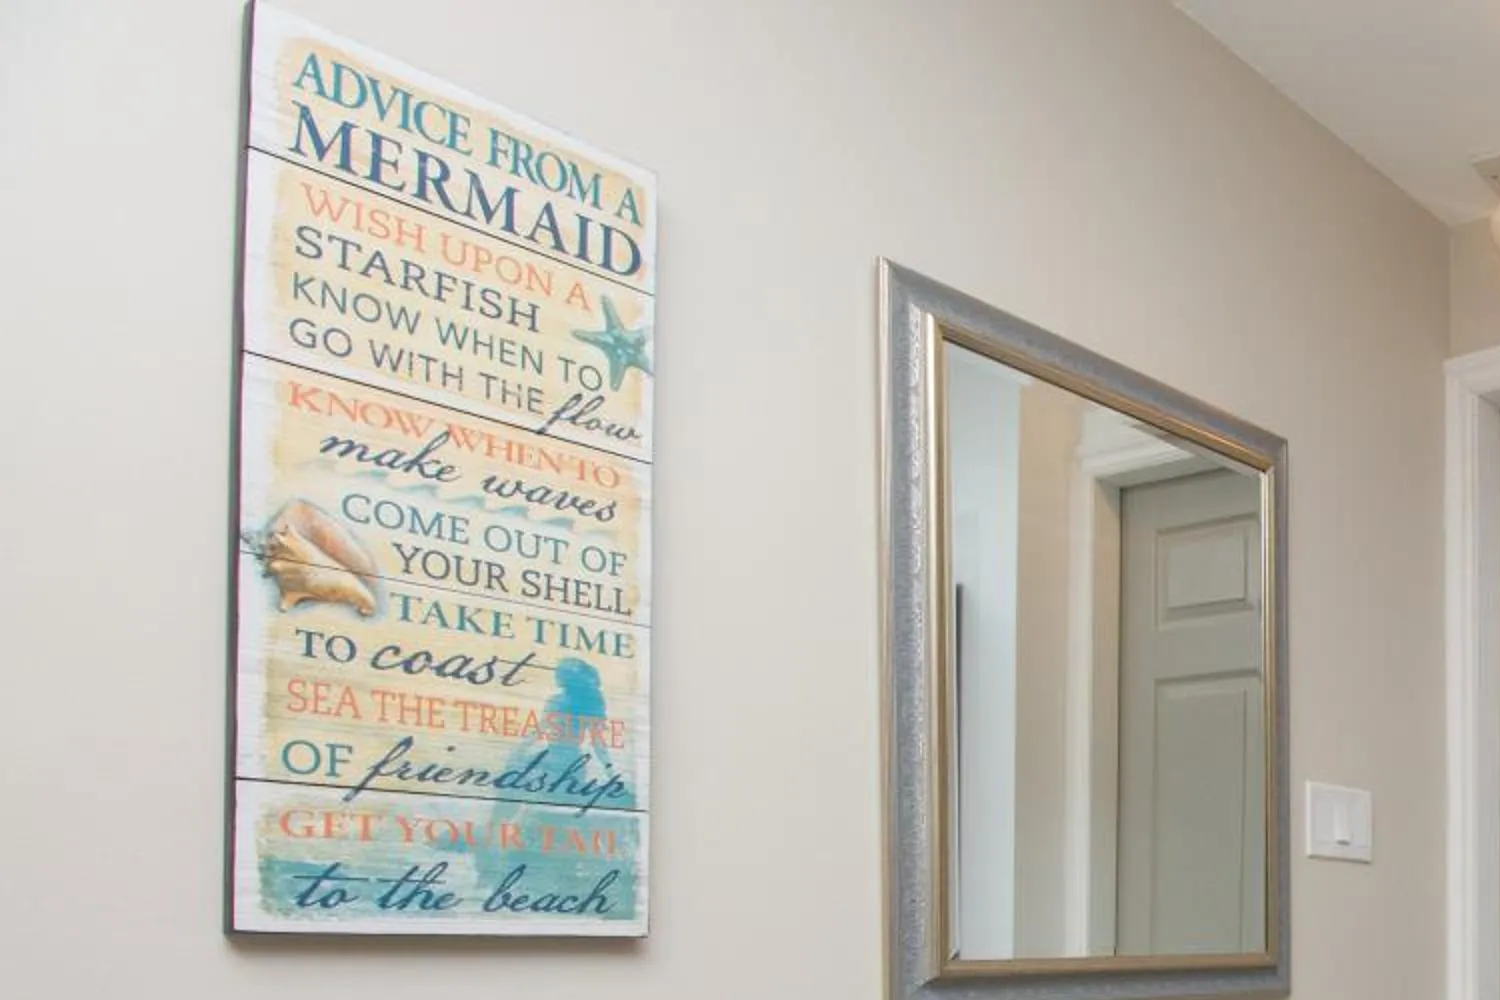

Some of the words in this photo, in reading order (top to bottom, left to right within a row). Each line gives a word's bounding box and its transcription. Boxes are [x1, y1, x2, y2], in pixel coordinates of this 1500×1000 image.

[292, 52, 473, 157] ADVICE
[485, 128, 602, 211] FROM
[614, 186, 643, 228] A
[288, 99, 642, 278] MERMAID
[294, 224, 540, 334] STARFISH
[301, 182, 427, 254] WISH
[439, 231, 555, 298] UPON
[565, 281, 592, 313] A
[292, 271, 422, 336] KNOW
[435, 317, 544, 376] WHEN
[558, 355, 602, 392] TO
[288, 317, 353, 358] GO
[368, 339, 465, 394] WITH
[478, 371, 545, 416] THE
[536, 392, 642, 442] flow
[287, 380, 434, 439] KNOW
[448, 424, 563, 476] WHEN
[569, 455, 621, 490] TO
[320, 429, 461, 483] make
[480, 472, 618, 523] waves
[341, 493, 470, 545] COME
[484, 524, 569, 565] OUT
[580, 545, 628, 578] OF
[392, 542, 509, 595] YOUR
[521, 569, 633, 617] SHELL
[295, 629, 358, 664] TO
[370, 643, 556, 687] coast
[388, 591, 515, 640] TAKE
[524, 614, 635, 660] TIME
[286, 678, 361, 720] SEA
[370, 689, 445, 730] THE
[453, 700, 626, 750] TREASURE
[281, 739, 353, 778] OF
[342, 736, 628, 818] friendship
[279, 808, 385, 844] GET
[395, 815, 526, 849] YOUR
[293, 861, 370, 910] to
[377, 861, 464, 912] the
[481, 864, 621, 915] beach
